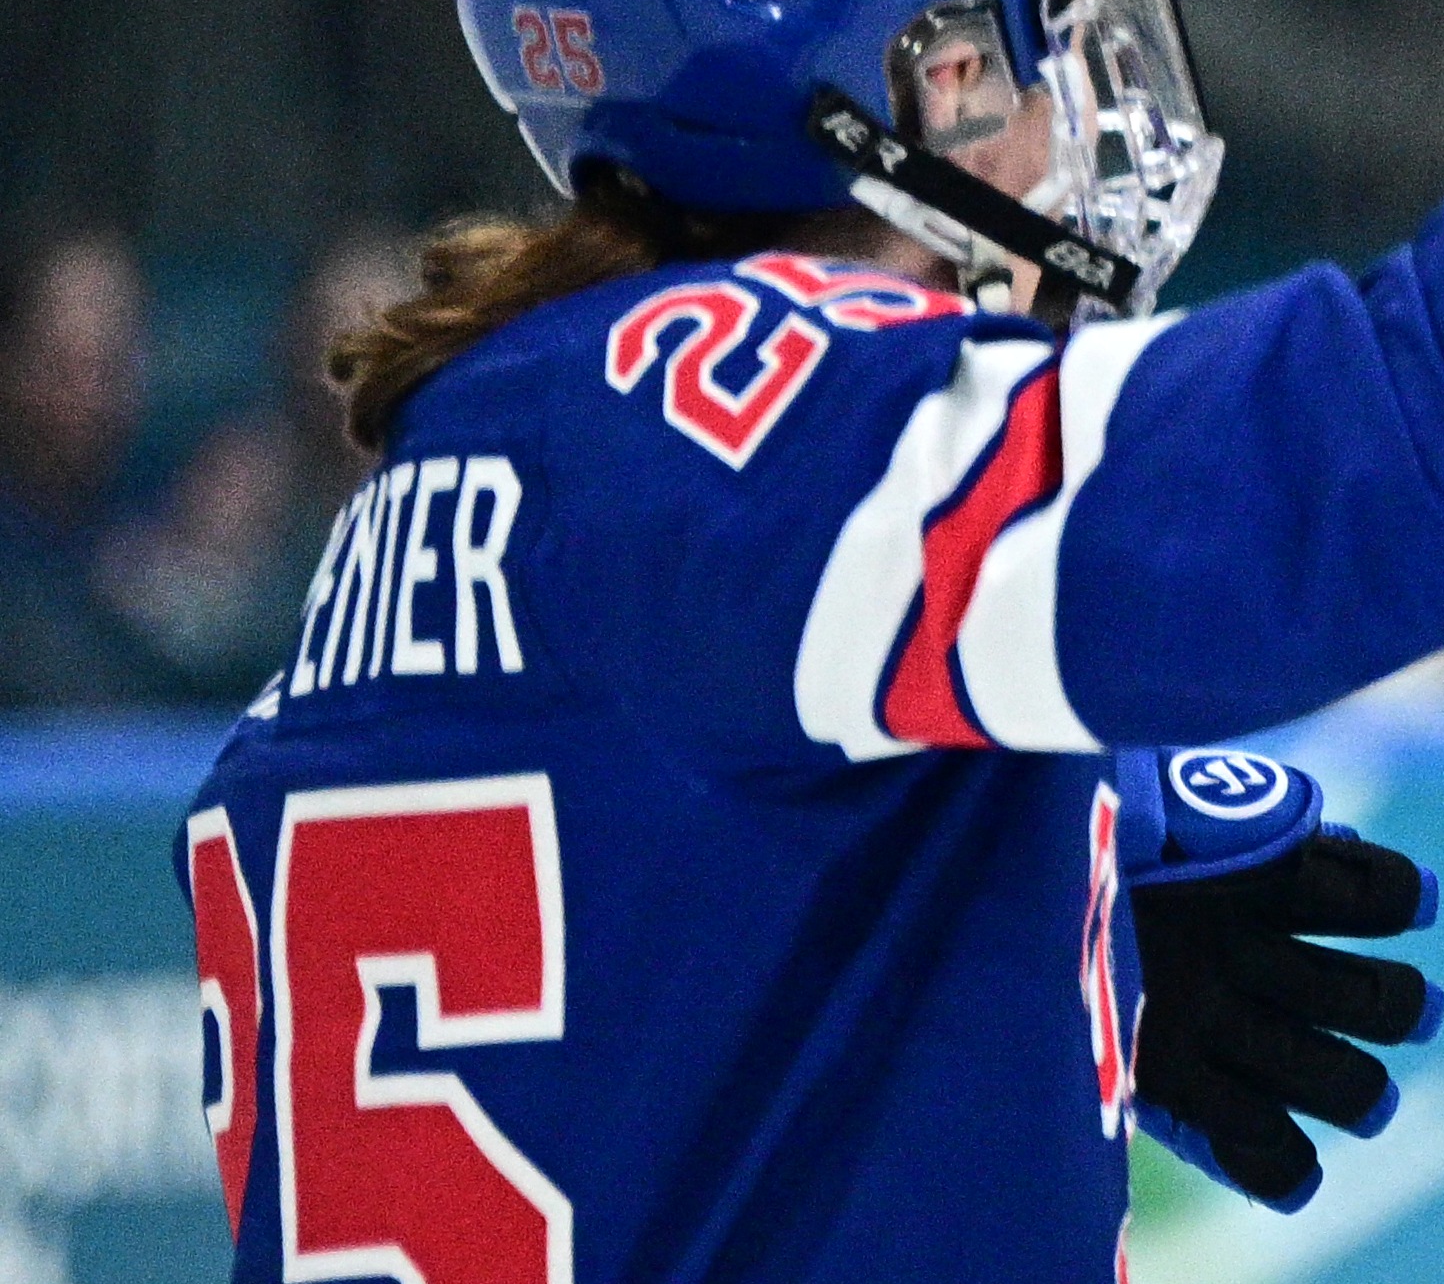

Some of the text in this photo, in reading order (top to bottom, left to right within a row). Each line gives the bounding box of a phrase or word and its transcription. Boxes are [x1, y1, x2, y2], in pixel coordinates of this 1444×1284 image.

[510, 7, 606, 97] 25
[606, 249, 976, 472] 25
[247, 454, 526, 719] ENTER
